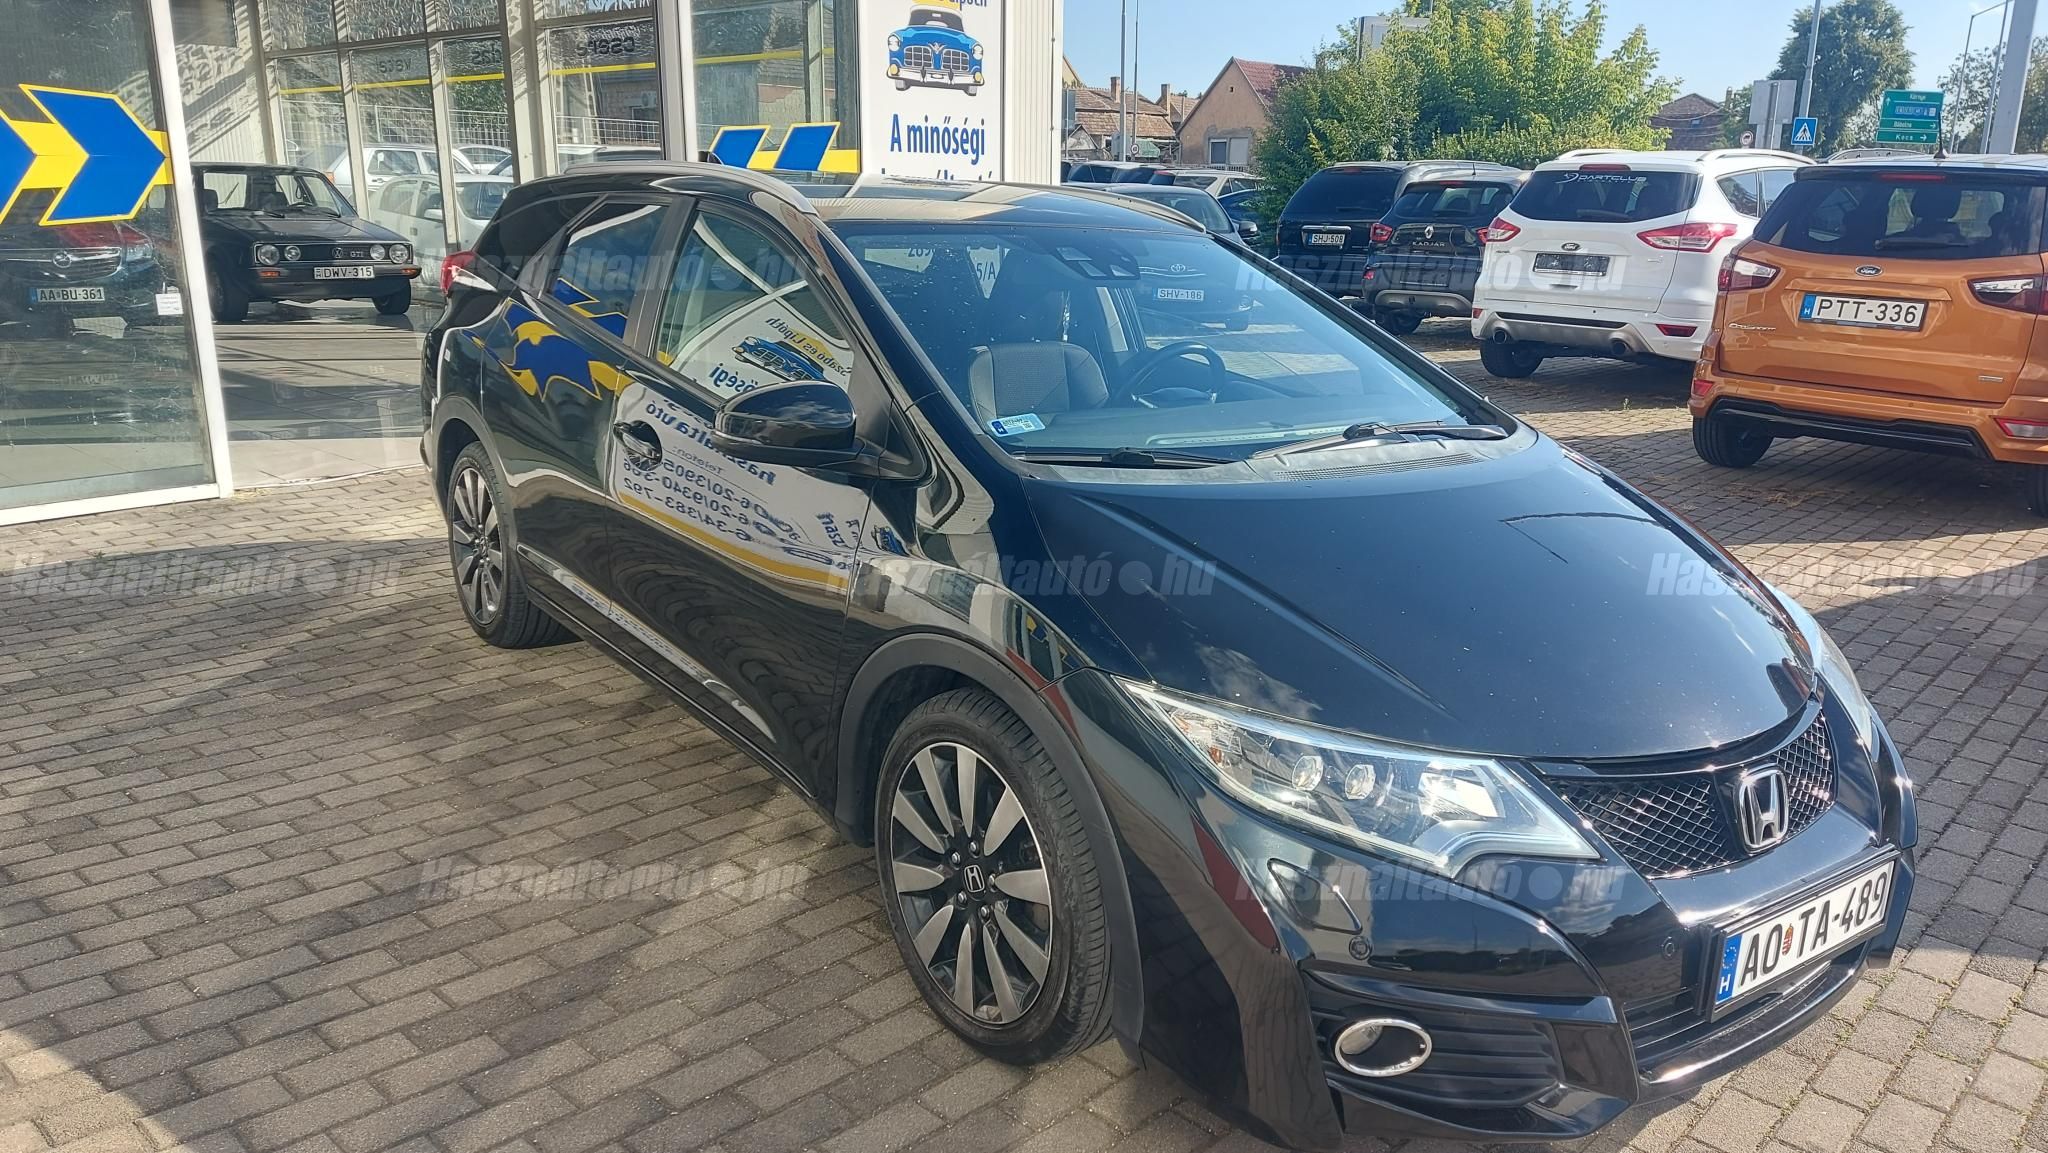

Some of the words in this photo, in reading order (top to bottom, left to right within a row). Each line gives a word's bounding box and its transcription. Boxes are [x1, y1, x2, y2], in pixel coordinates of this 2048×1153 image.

[890, 113, 903, 153] A
[906, 114, 985, 166] minőségi
[1411, 240, 1446, 248] KADJAR
[324, 267, 372, 278] DWV-315
[1816, 298, 1918, 324] PTT-336
